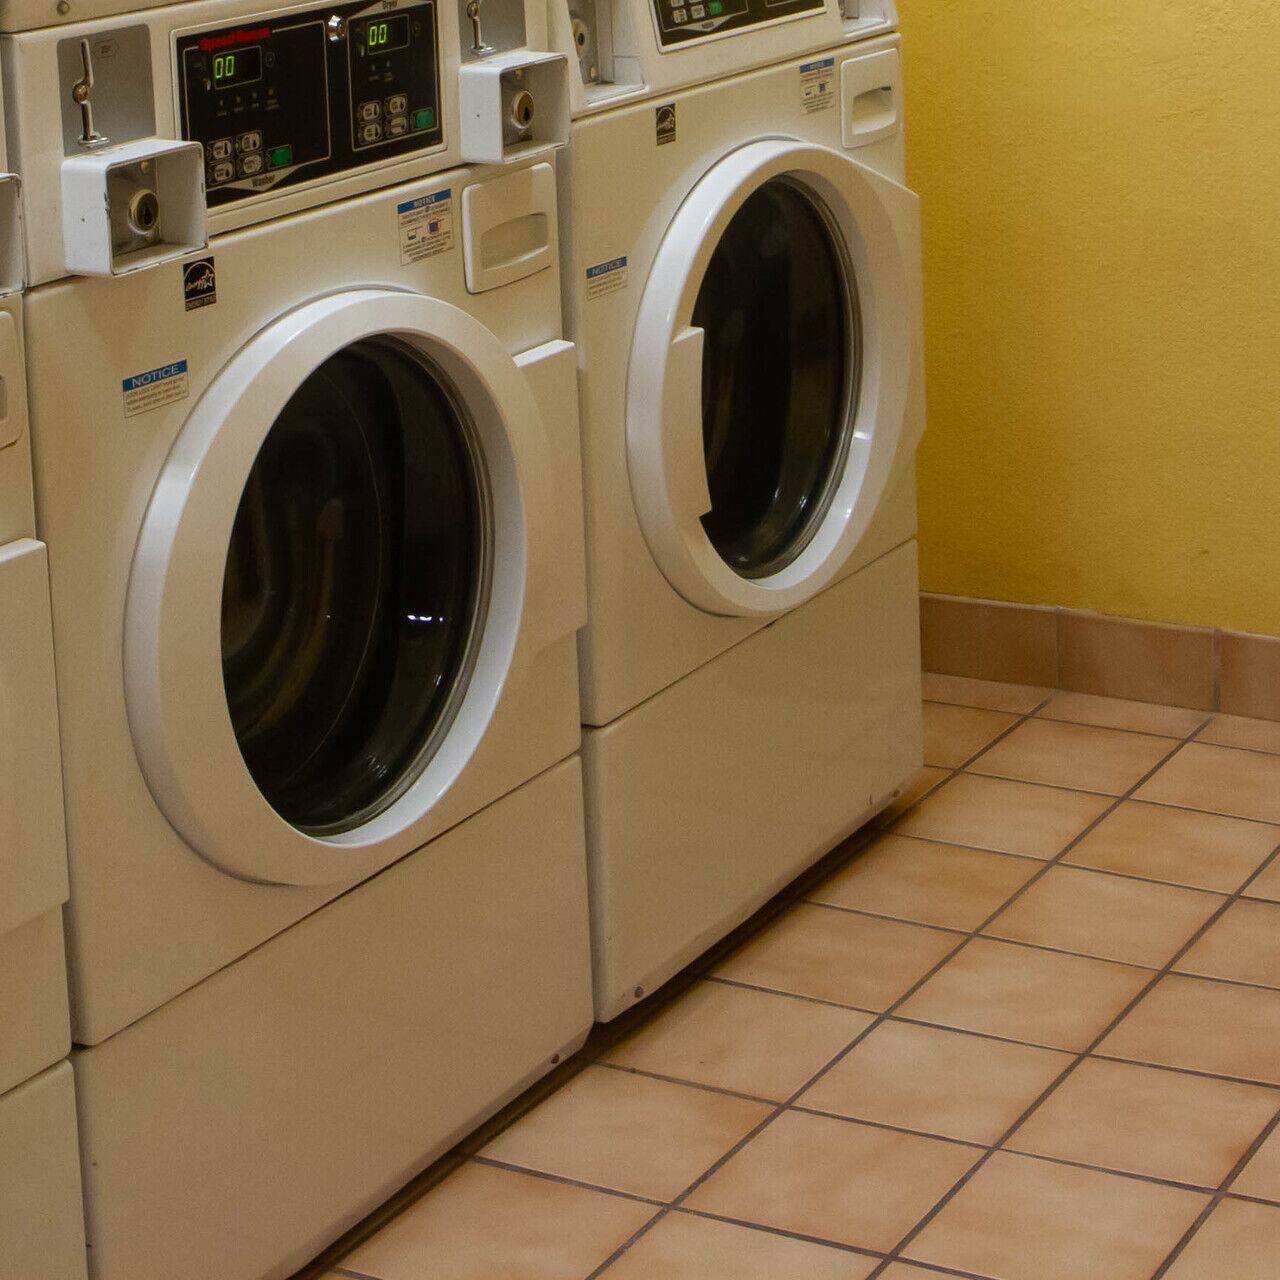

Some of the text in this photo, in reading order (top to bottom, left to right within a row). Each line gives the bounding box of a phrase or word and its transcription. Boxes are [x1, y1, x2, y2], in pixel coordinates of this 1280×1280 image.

[369, 24, 388, 46] 00
[215, 55, 235, 79] 00
[132, 364, 180, 388] NOTICE
